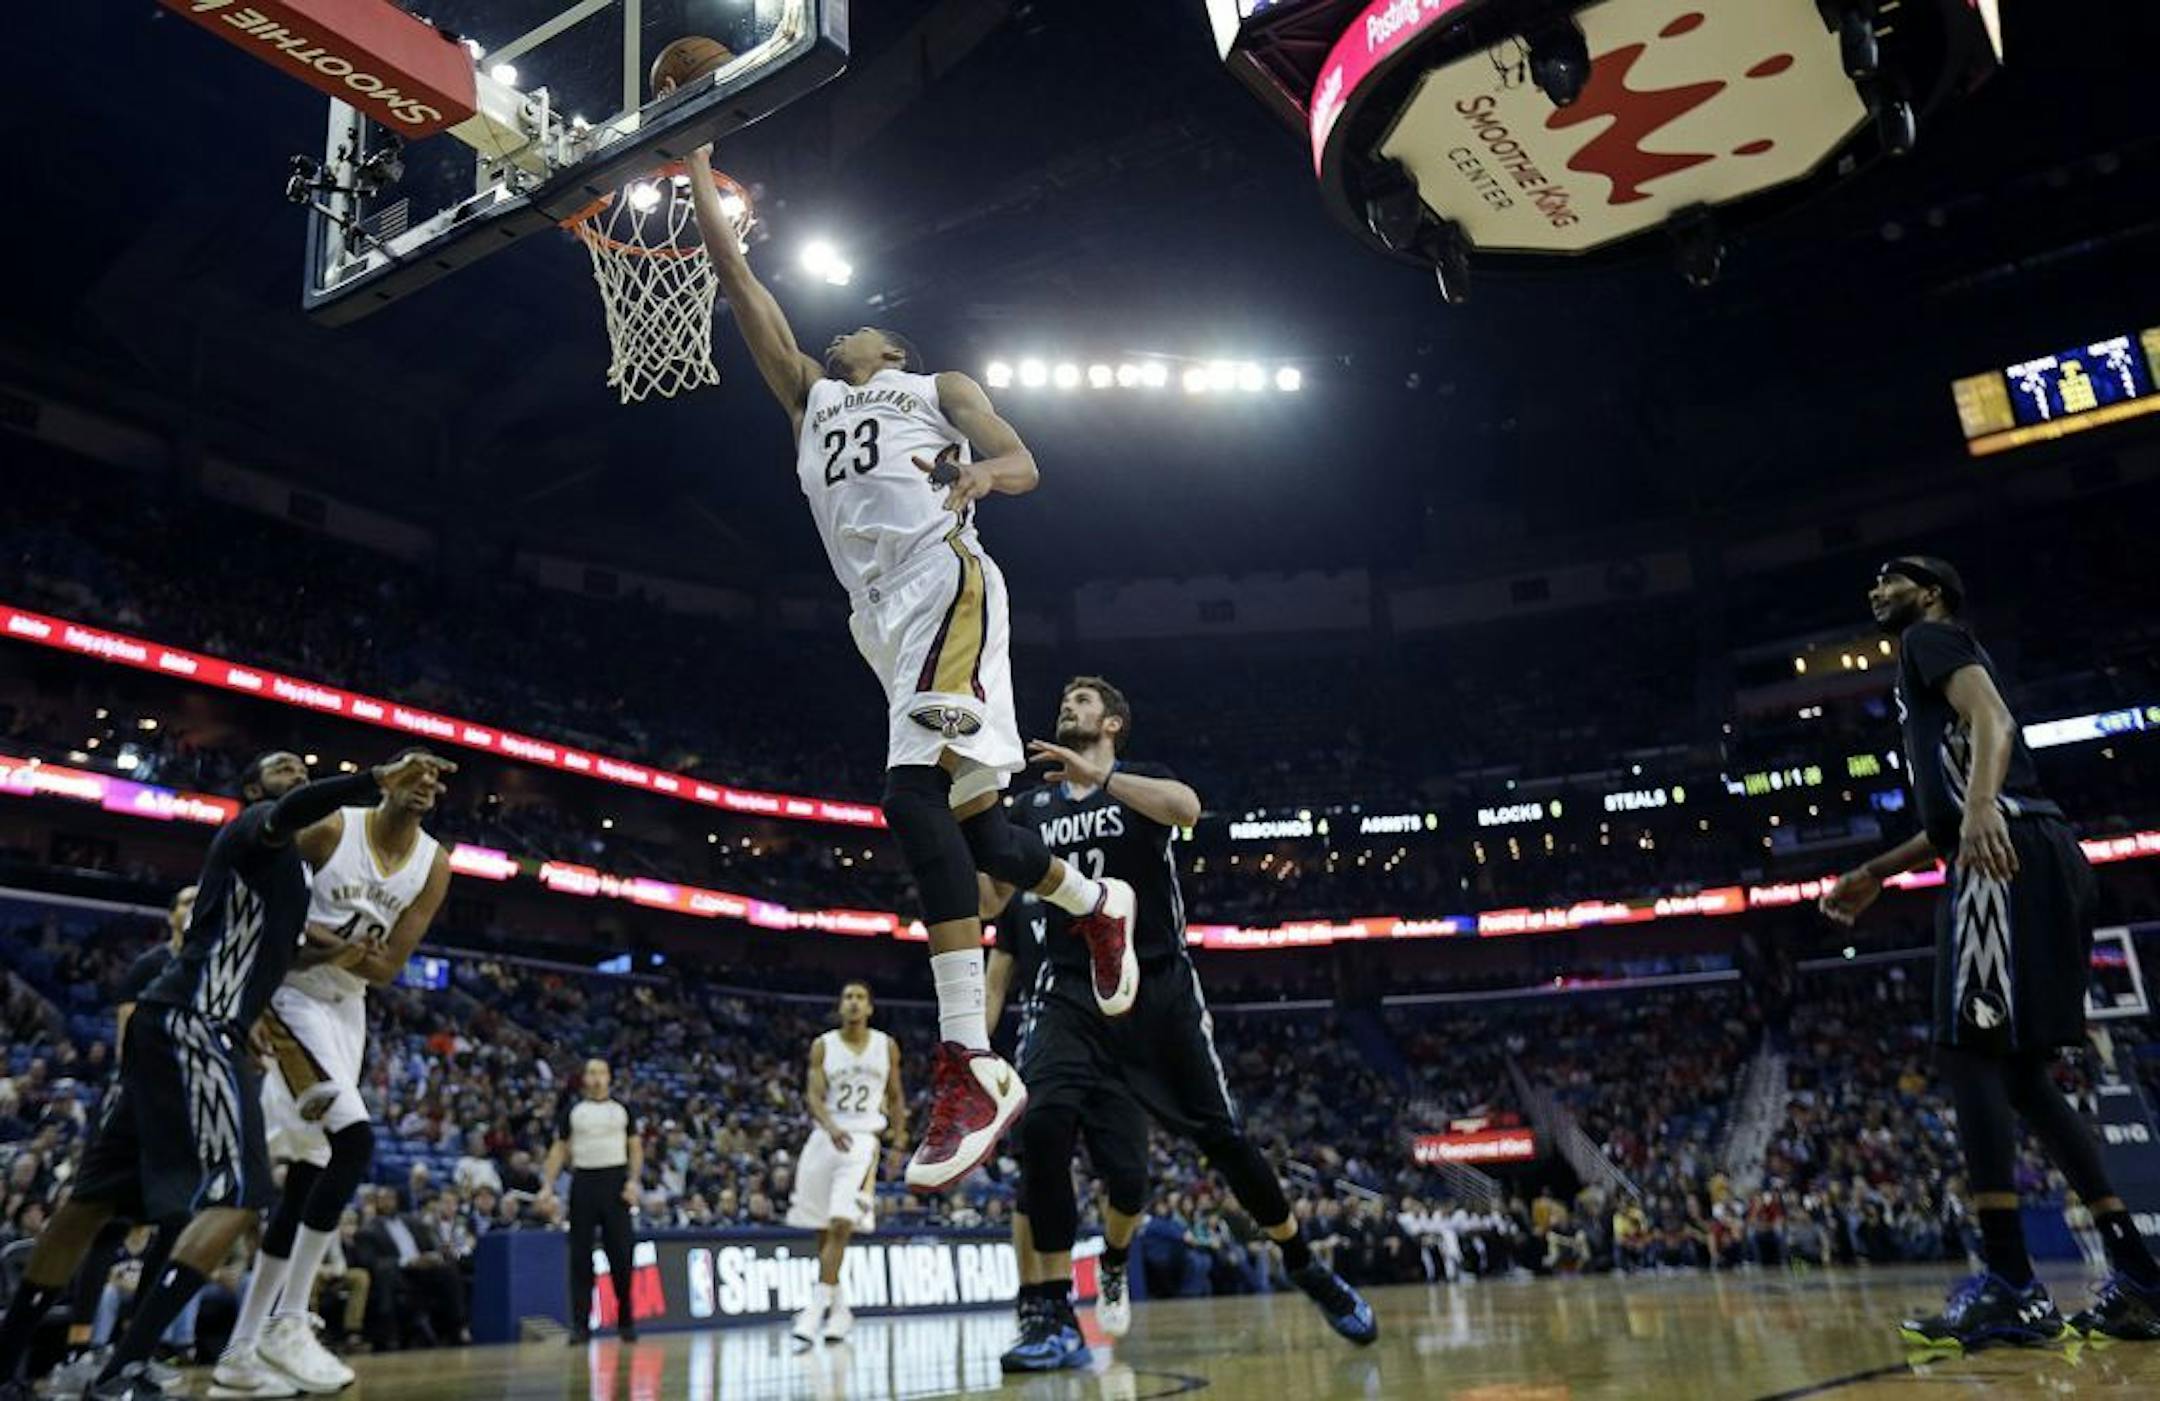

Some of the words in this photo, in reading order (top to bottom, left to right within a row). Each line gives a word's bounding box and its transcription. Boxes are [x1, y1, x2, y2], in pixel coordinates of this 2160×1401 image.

[222, 8, 442, 125] SMOOTHIE
[1448, 147, 1514, 212] CENTER
[1455, 95, 1548, 188] SMOOTHIE
[1526, 186, 1580, 228] KING
[844, 390, 917, 414] ORLEANS
[824, 418, 880, 488] 23
[1477, 803, 1544, 826] BLOCKS
[1603, 788, 1668, 812] STEALS
[1039, 804, 1125, 848] WOLVES
[1229, 819, 1314, 840] REBOUNDS
[1360, 815, 1422, 834] ASSISTS
[837, 1082, 870, 1113] 22
[888, 1243, 960, 1306] NBA
[956, 1243, 1021, 1302] RAD
